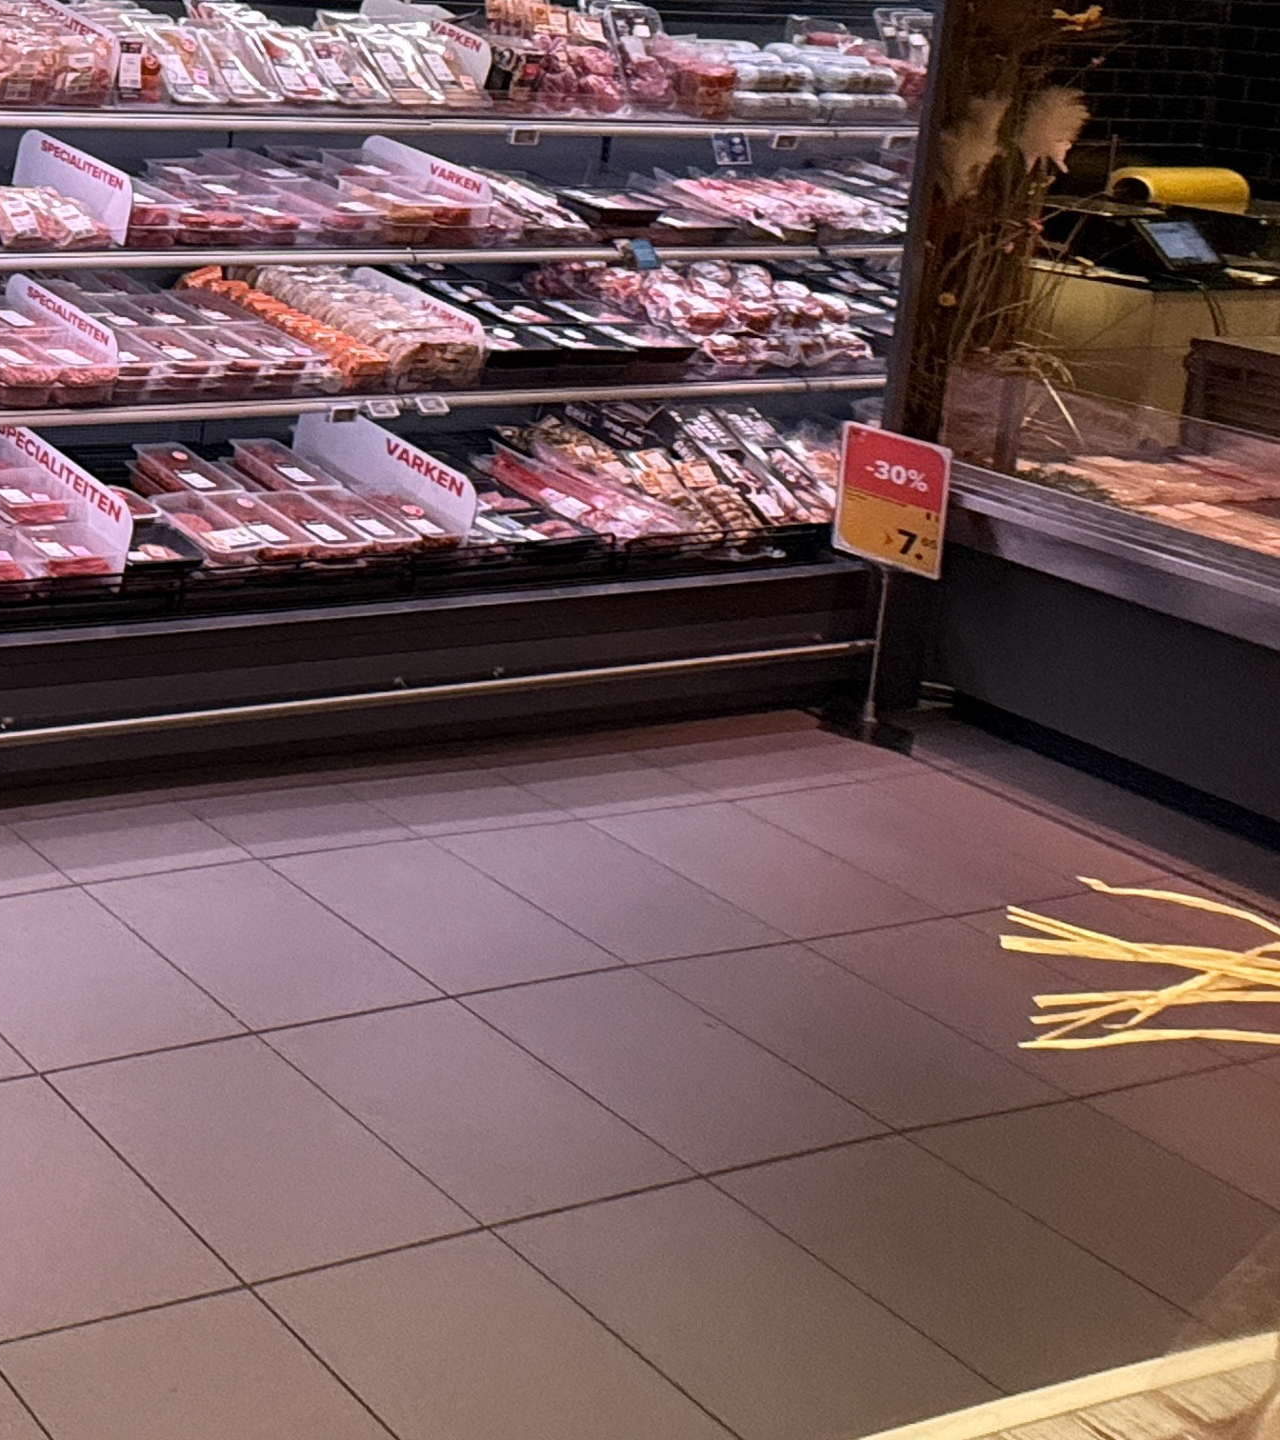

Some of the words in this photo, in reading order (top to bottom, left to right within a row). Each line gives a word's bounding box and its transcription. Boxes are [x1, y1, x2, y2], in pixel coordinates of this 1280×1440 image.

[430, 20, 482, 53] VARKEN
[40, 139, 125, 190] SPECIALITEITEN
[429, 162, 481, 194] VARKEN
[26, 285, 111, 346] SPECIALITEITEN
[386, 437, 465, 498] VARKEN
[864, 460, 929, 493] -30%
